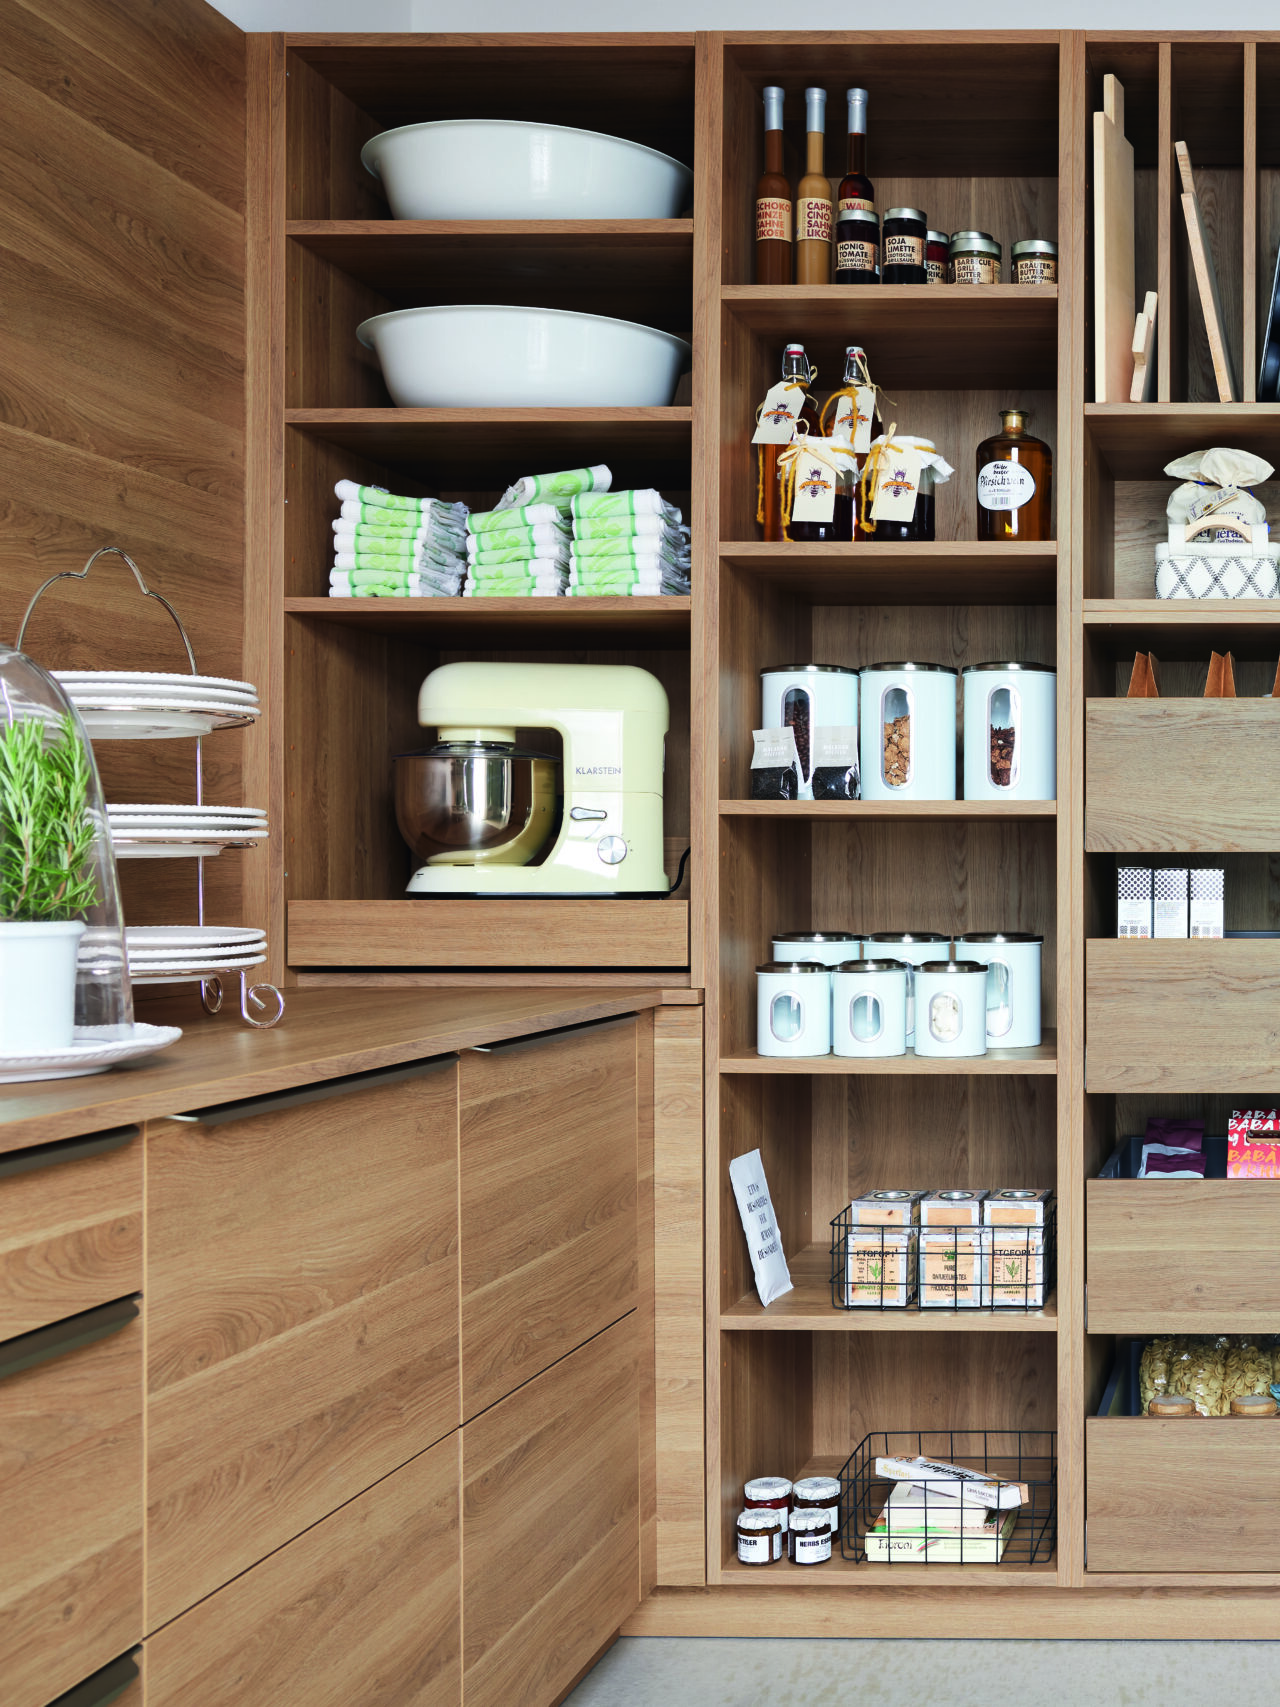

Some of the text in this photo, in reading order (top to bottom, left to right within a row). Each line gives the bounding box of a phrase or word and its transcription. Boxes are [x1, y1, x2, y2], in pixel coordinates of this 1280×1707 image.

[757, 202, 791, 213] SCHOKO
[807, 211, 830, 221] CINO
[757, 229, 785, 238] LIKOER
[888, 238, 906, 246] SOJA
[888, 245, 916, 253] LIMETTE
[840, 251, 868, 259] TOMATE
[957, 271, 981, 279] BUTTER
[576, 767, 622, 775] KLARSTEIN
[1228, 1145, 1277, 1164] BABÀ
[799, 1540, 820, 1548] HERBS
